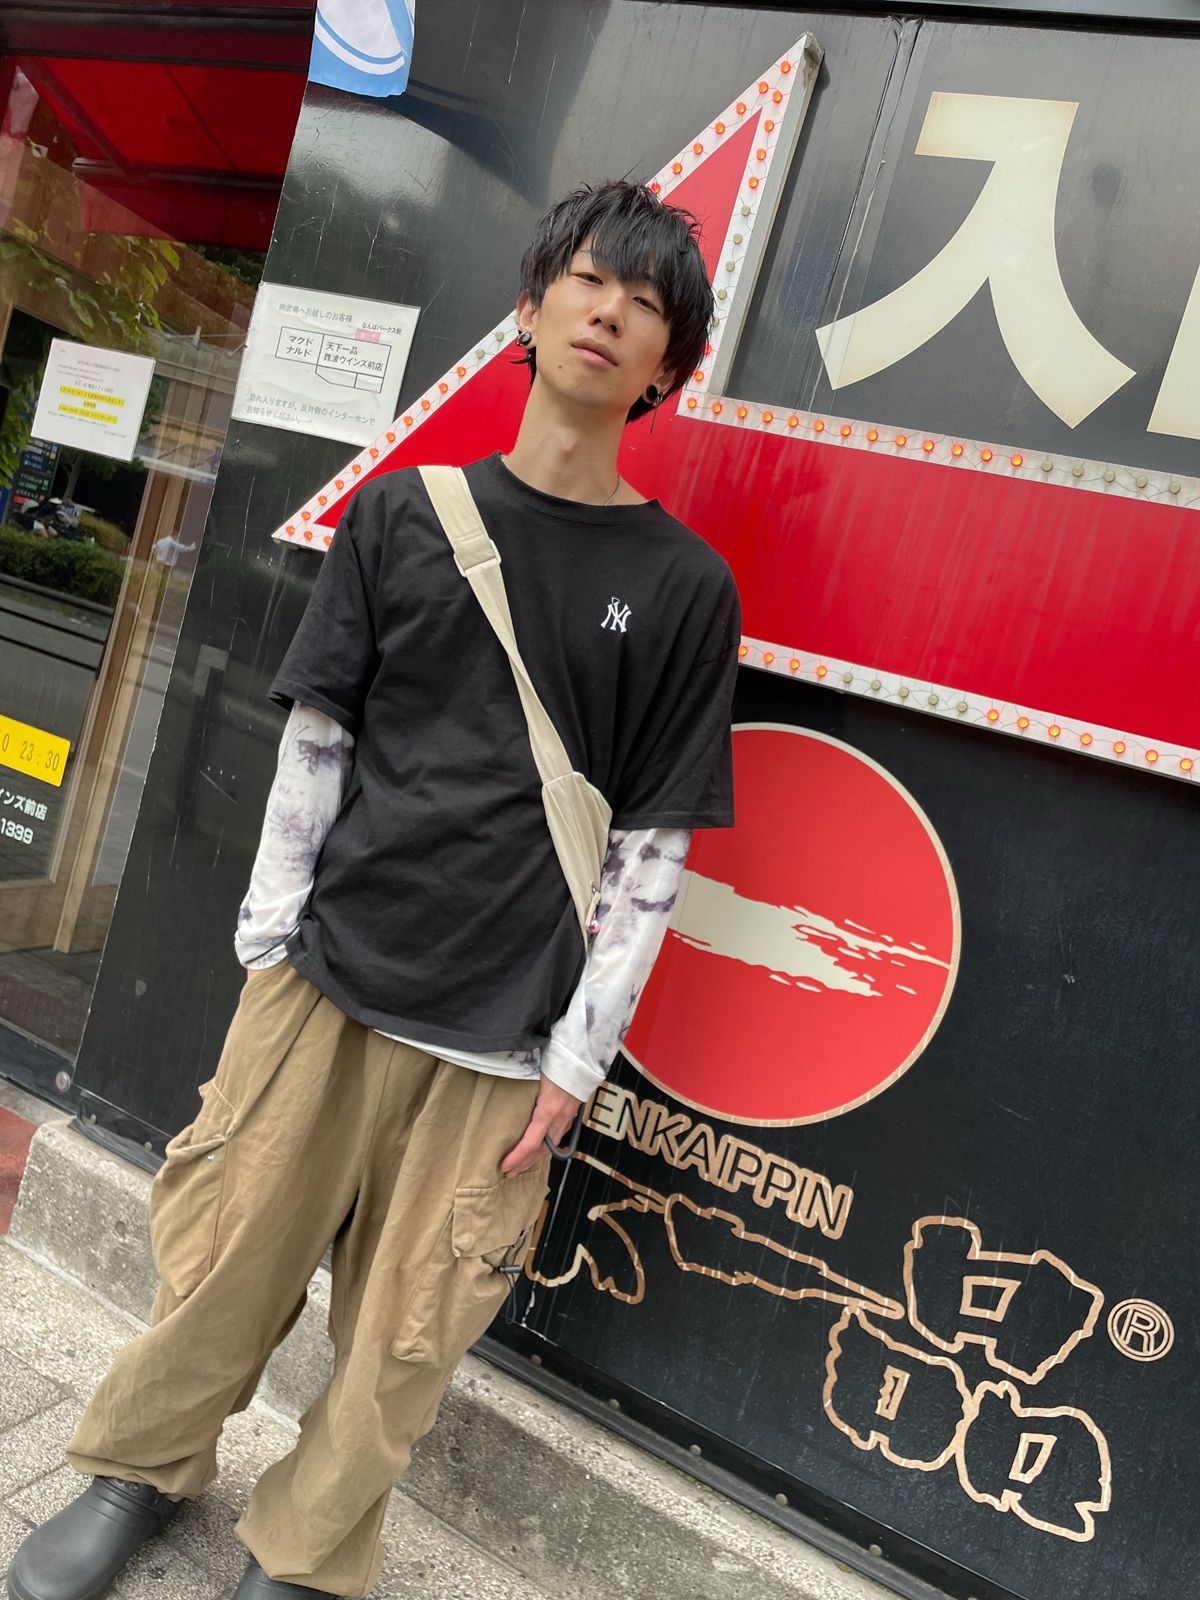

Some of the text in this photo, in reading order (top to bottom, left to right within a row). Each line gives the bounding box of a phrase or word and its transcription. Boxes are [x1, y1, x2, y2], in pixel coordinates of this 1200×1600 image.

[815, 91, 1200, 440] ス
[289, 335, 315, 346] マクド
[326, 341, 359, 356] 天下一品
[286, 346, 312, 357] ナルド
[323, 352, 384, 372] 難波ウインズ前店
[1, 817, 34, 845] 1339
